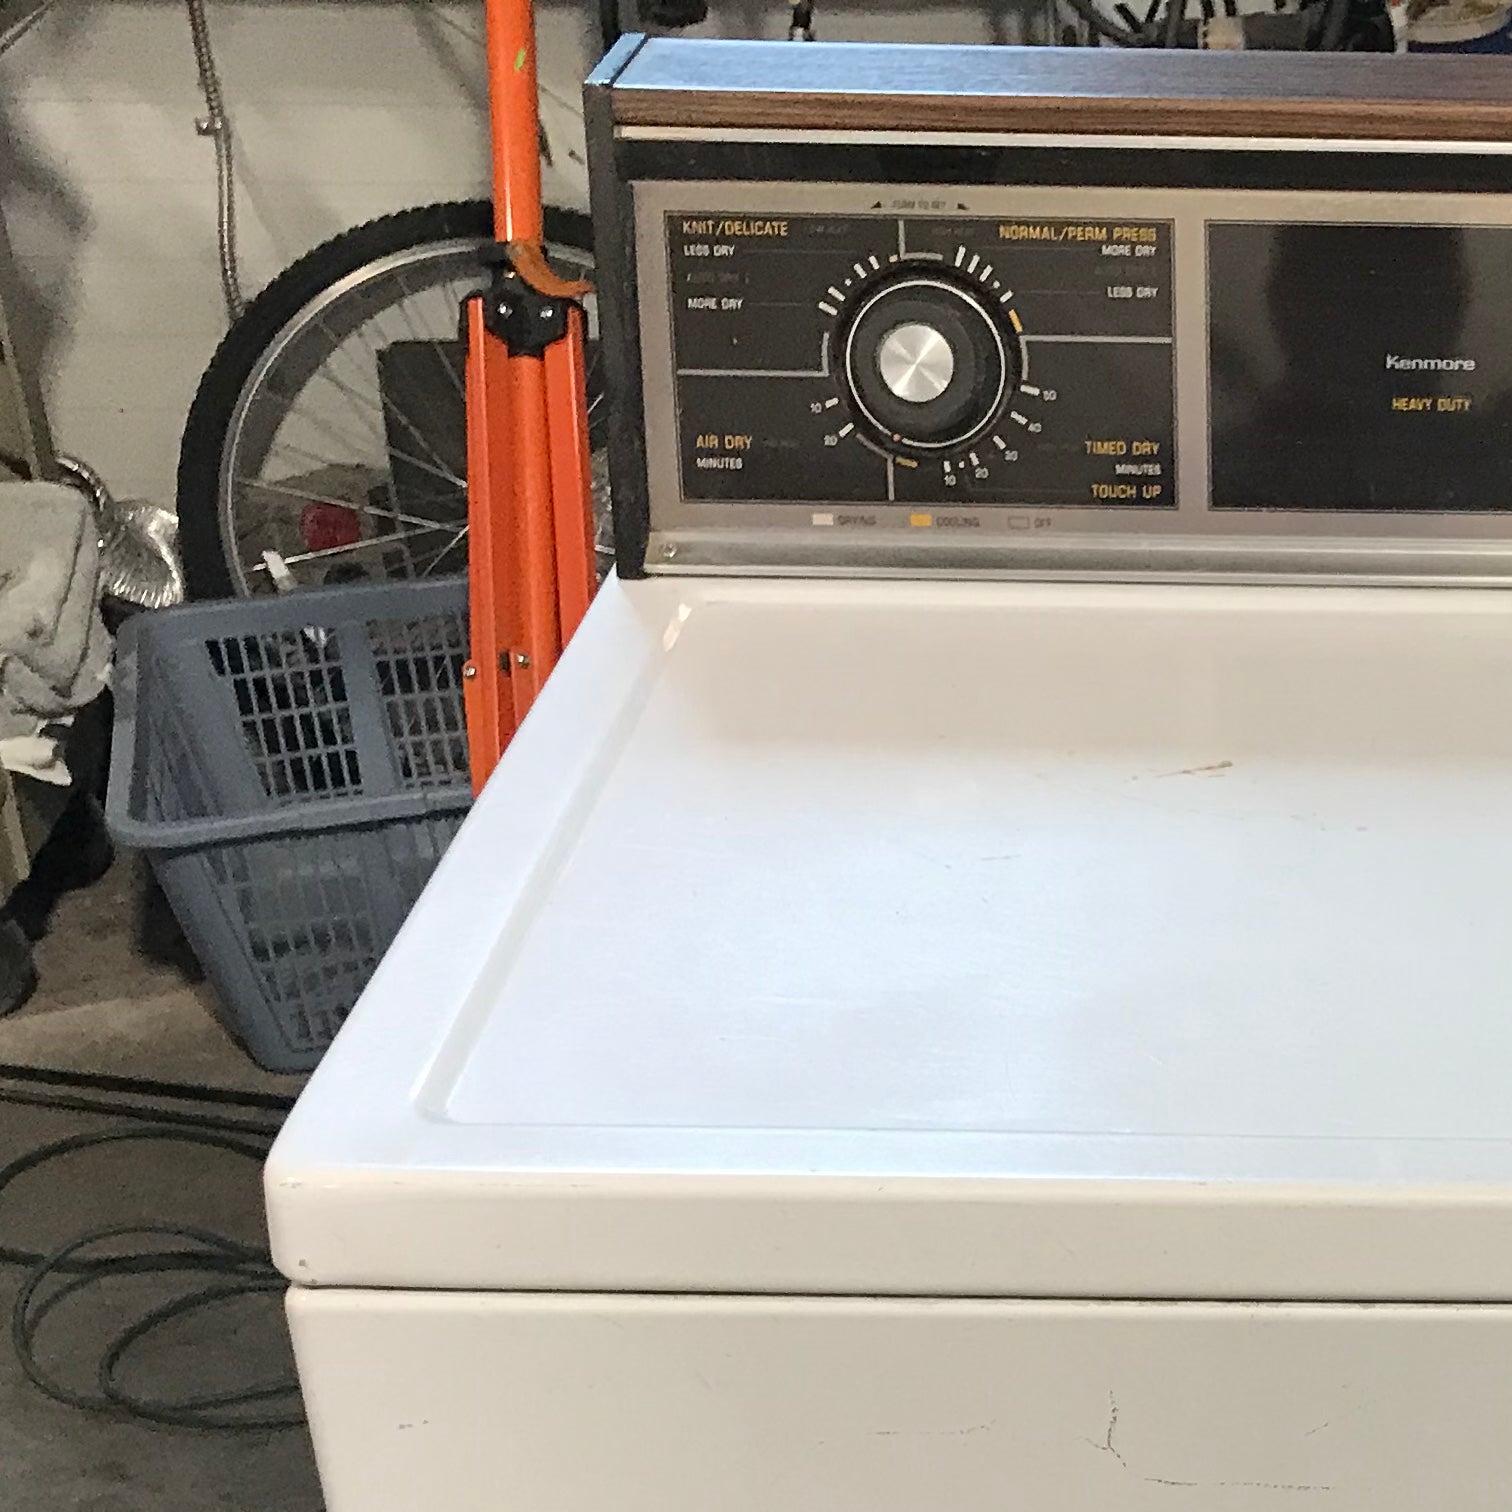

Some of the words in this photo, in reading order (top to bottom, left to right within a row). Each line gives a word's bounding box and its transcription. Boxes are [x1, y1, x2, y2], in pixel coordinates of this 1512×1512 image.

[682, 220, 789, 237] KNIT/DELICATE
[999, 224, 1108, 242] NORMAL/PERM
[1112, 226, 1157, 242] PRESS
[683, 244, 710, 257] LESS
[713, 243, 736, 257] DRY
[1101, 244, 1132, 257] MORE
[1135, 244, 1157, 257] DRY
[1107, 285, 1133, 298] LESS
[1136, 286, 1159, 298] DRY
[687, 297, 718, 310] MORE
[721, 297, 744, 310] DRY
[1385, 352, 1477, 371] Kenmore
[810, 401, 823, 414] 10
[1392, 397, 1433, 411] HEAVY
[1437, 397, 1472, 412] DUTY
[696, 434, 719, 449] AIR
[724, 434, 753, 450] DRY
[1084, 440, 1127, 455] TIMED
[1132, 441, 1161, 456] DRY
[696, 456, 743, 470] MINUTES
[1114, 463, 1162, 476] MINUTES
[943, 474, 957, 487] 10
[1090, 483, 1137, 499] TOUCH
[1142, 484, 1163, 499] UP
